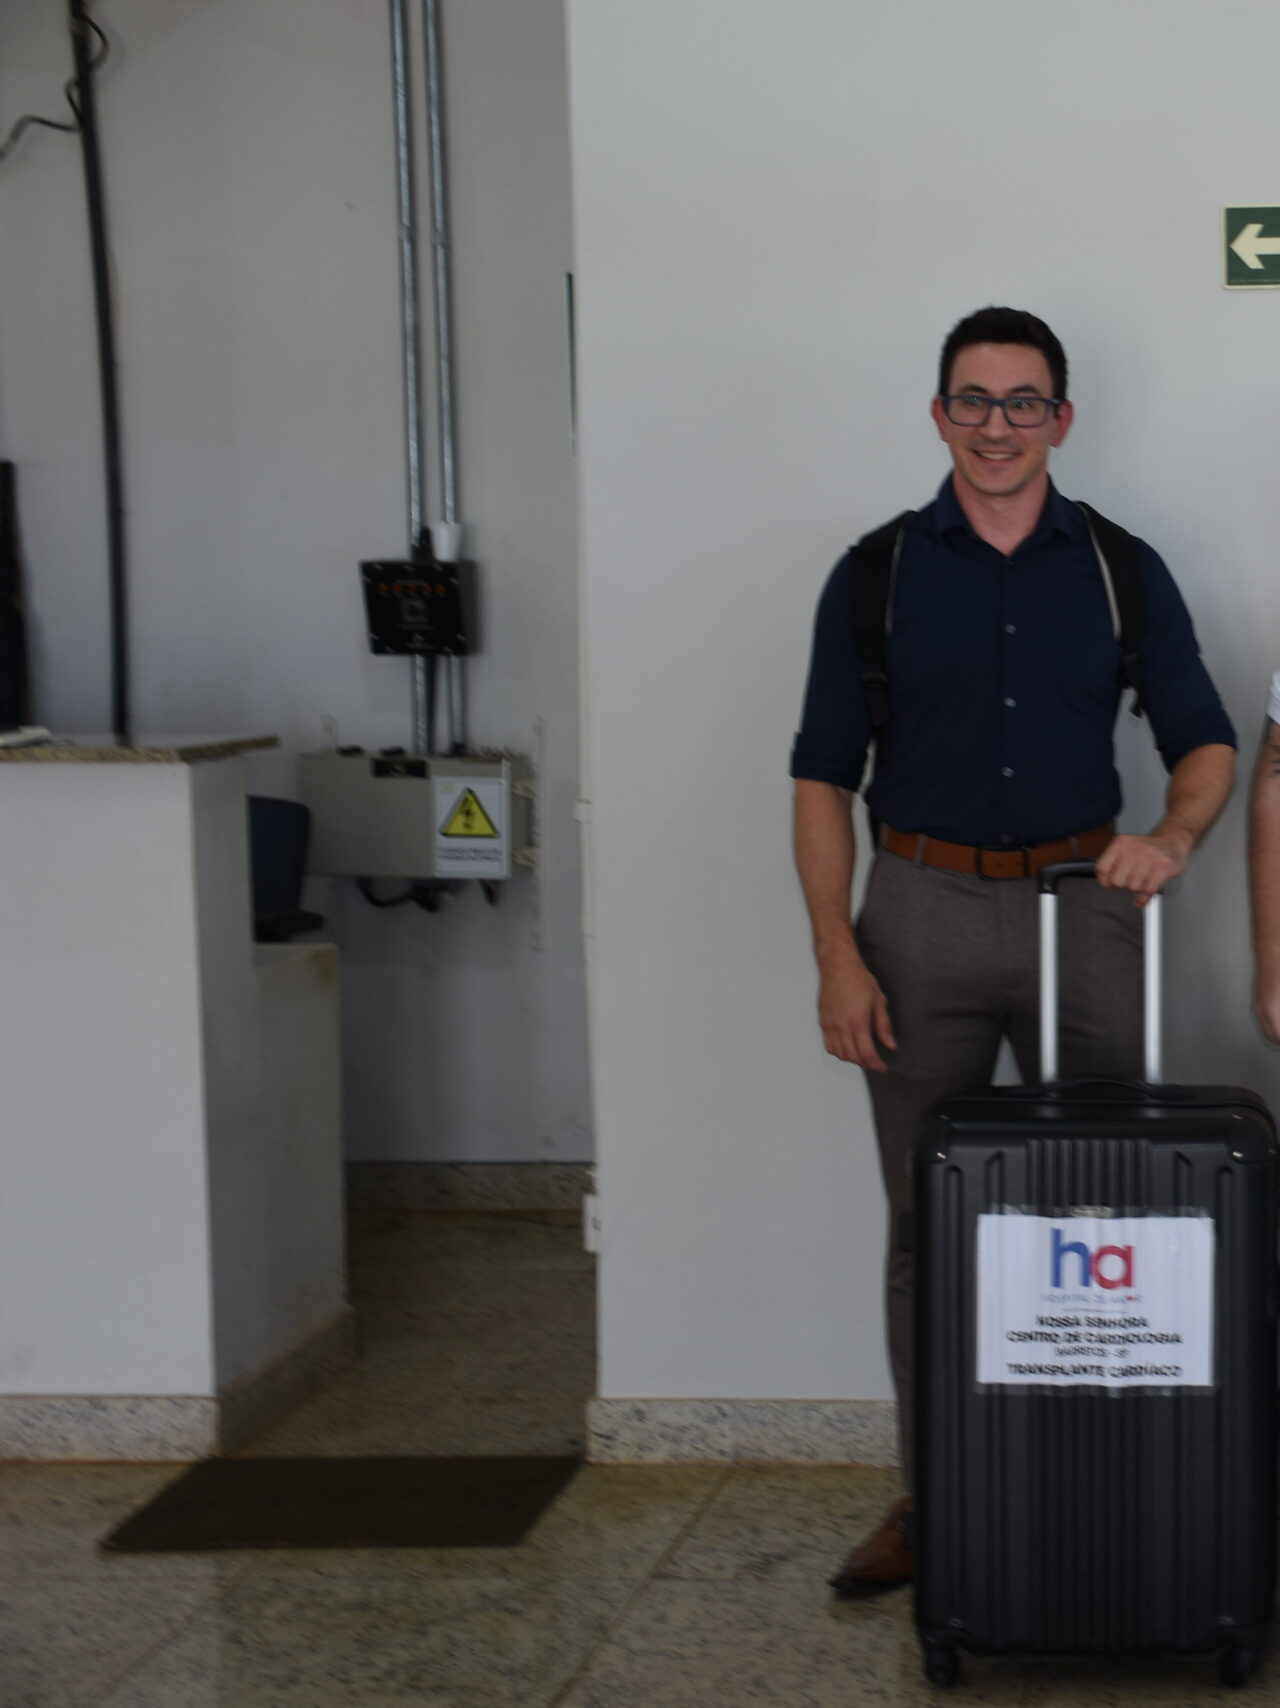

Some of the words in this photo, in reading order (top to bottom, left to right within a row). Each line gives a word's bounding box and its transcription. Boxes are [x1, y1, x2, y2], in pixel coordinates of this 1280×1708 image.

[1051, 1227, 1135, 1290] ha
[1036, 1315, 1082, 1328] NOSSA
[1085, 1316, 1150, 1329] SENHORA
[1006, 1330, 1060, 1343] CENTRO
[1064, 1332, 1083, 1343] DE
[1085, 1332, 1184, 1344] CARDIOLOGIA
[1006, 1363, 1106, 1376] TRANSPLANTE
